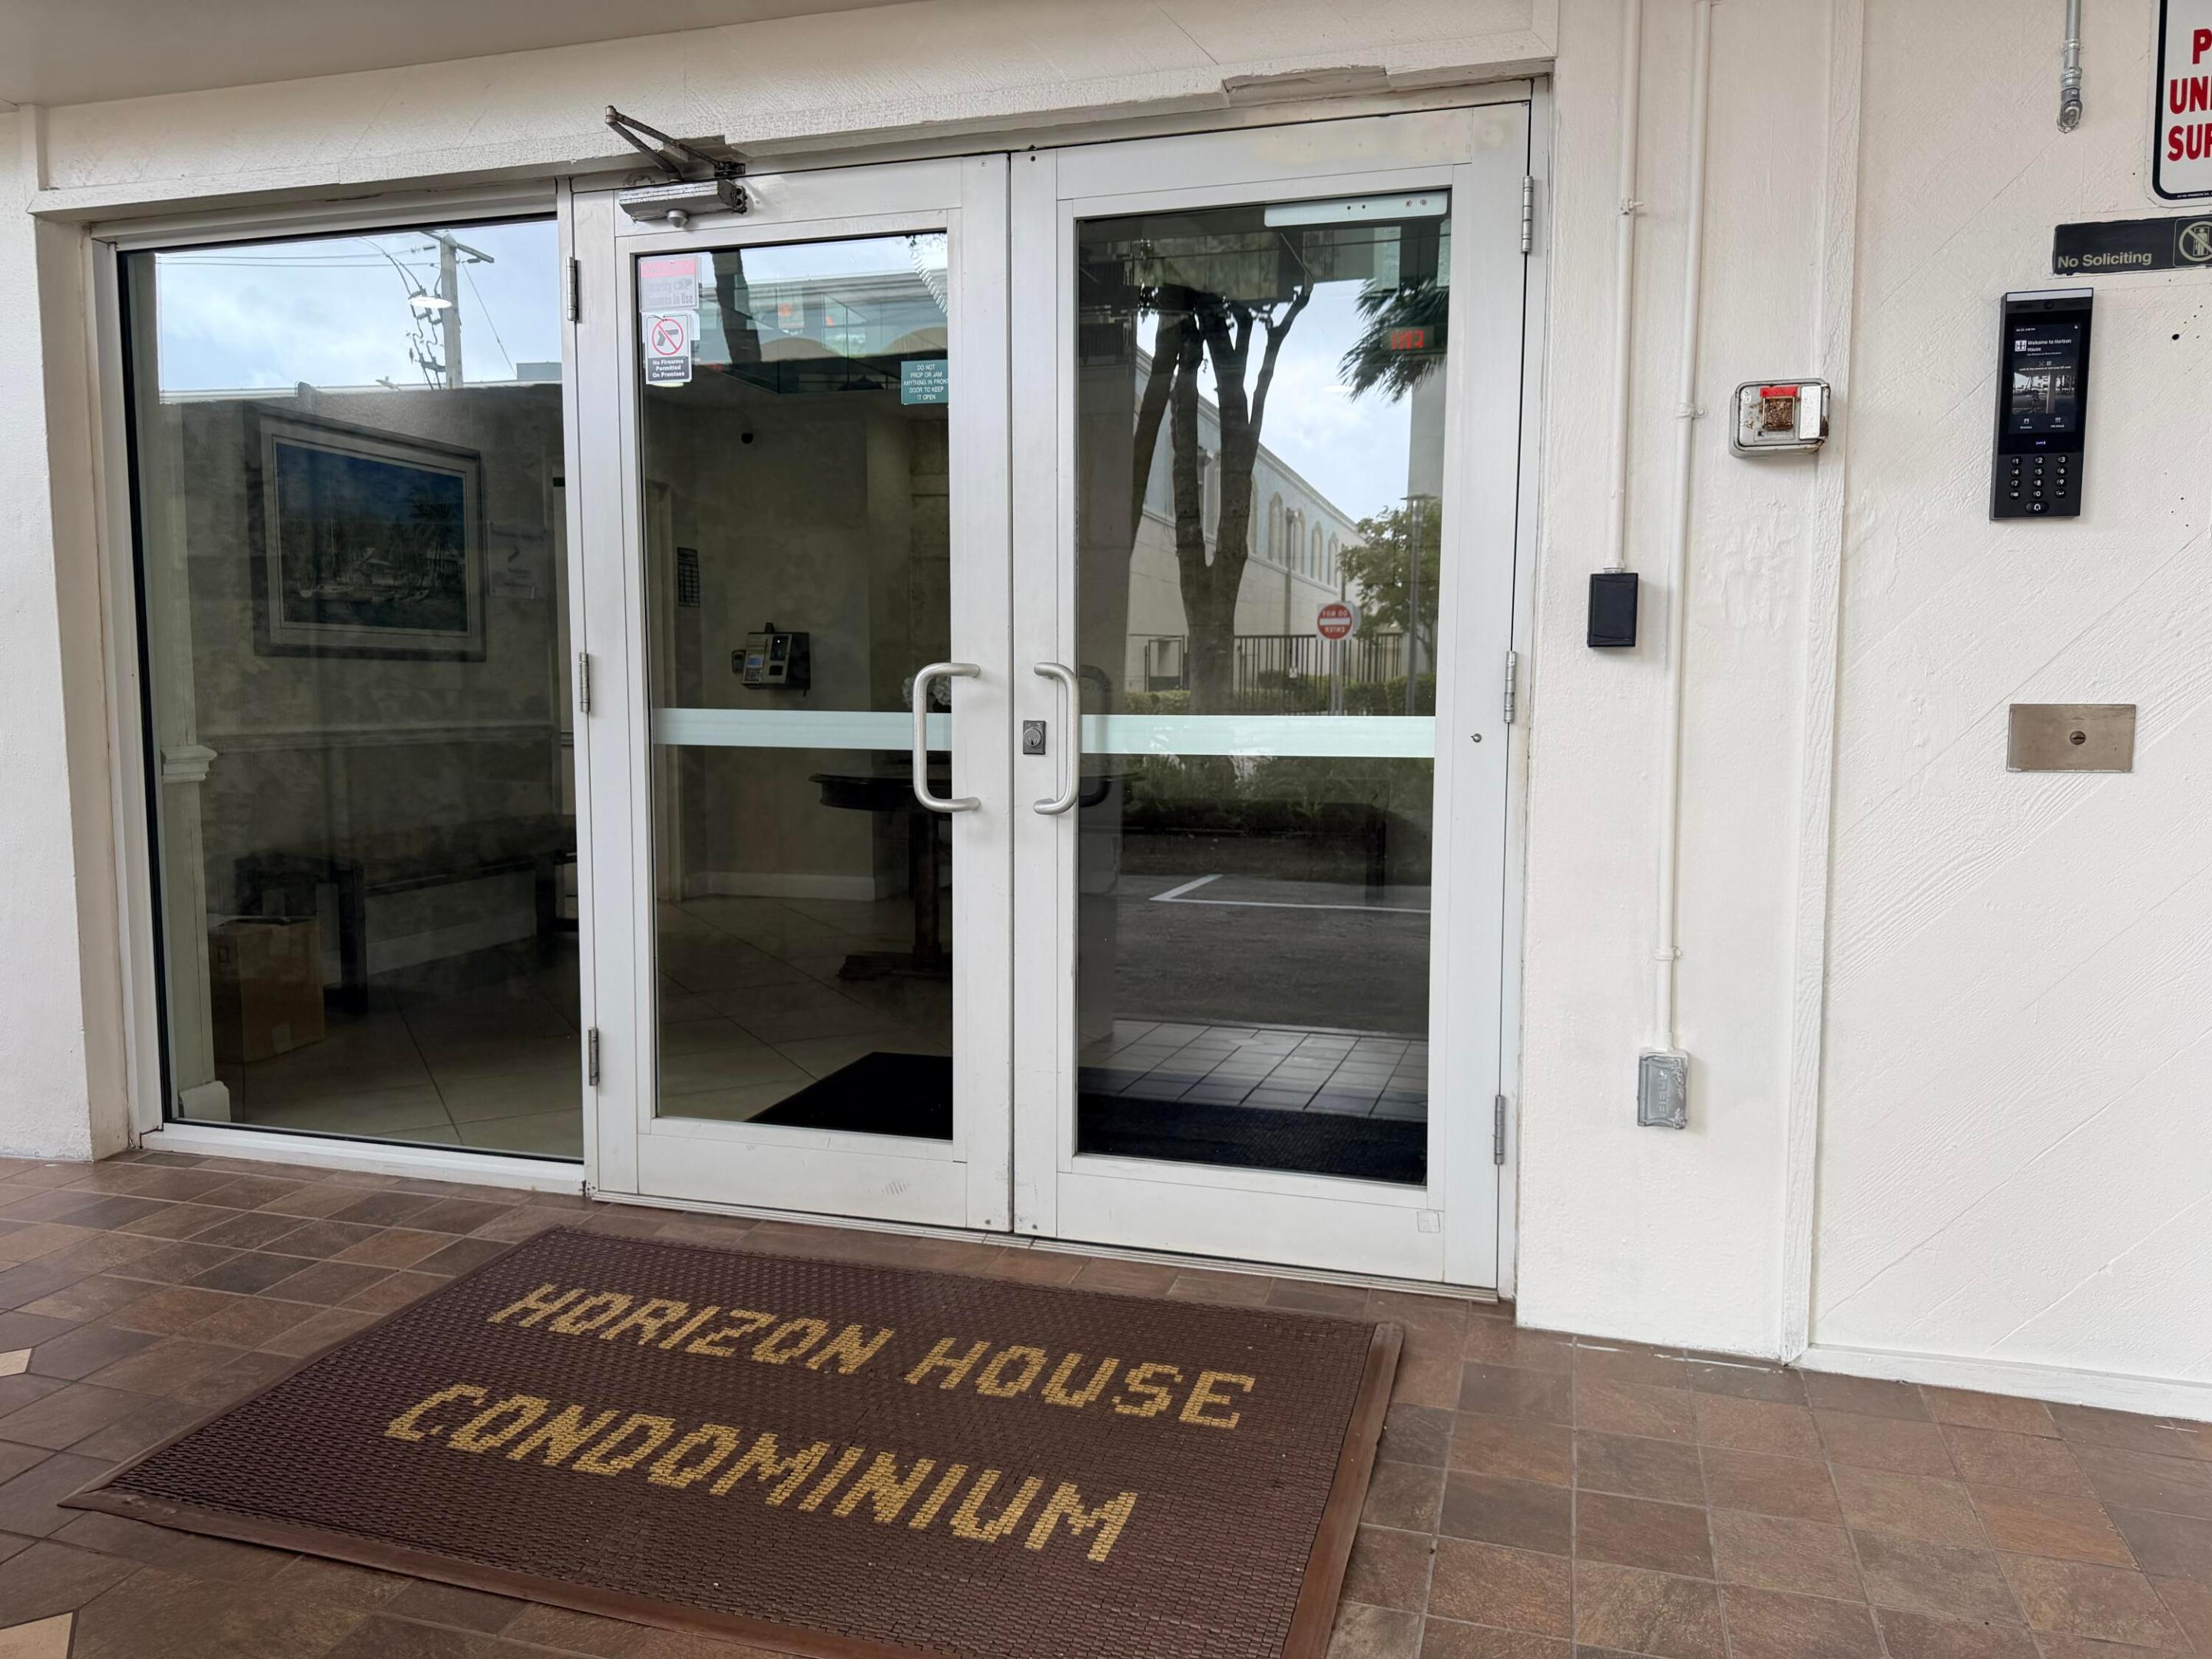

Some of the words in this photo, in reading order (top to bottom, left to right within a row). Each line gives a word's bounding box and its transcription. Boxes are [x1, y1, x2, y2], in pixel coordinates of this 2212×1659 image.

[2170, 76, 2212, 114] UN
[2058, 256, 2078, 268] No
[2082, 251, 2152, 267] Soliciting
[486, 1282, 896, 1375] HORIZON
[903, 1337, 1256, 1429] HOUSE
[383, 1383, 1139, 1563] CONDOMINIUM
